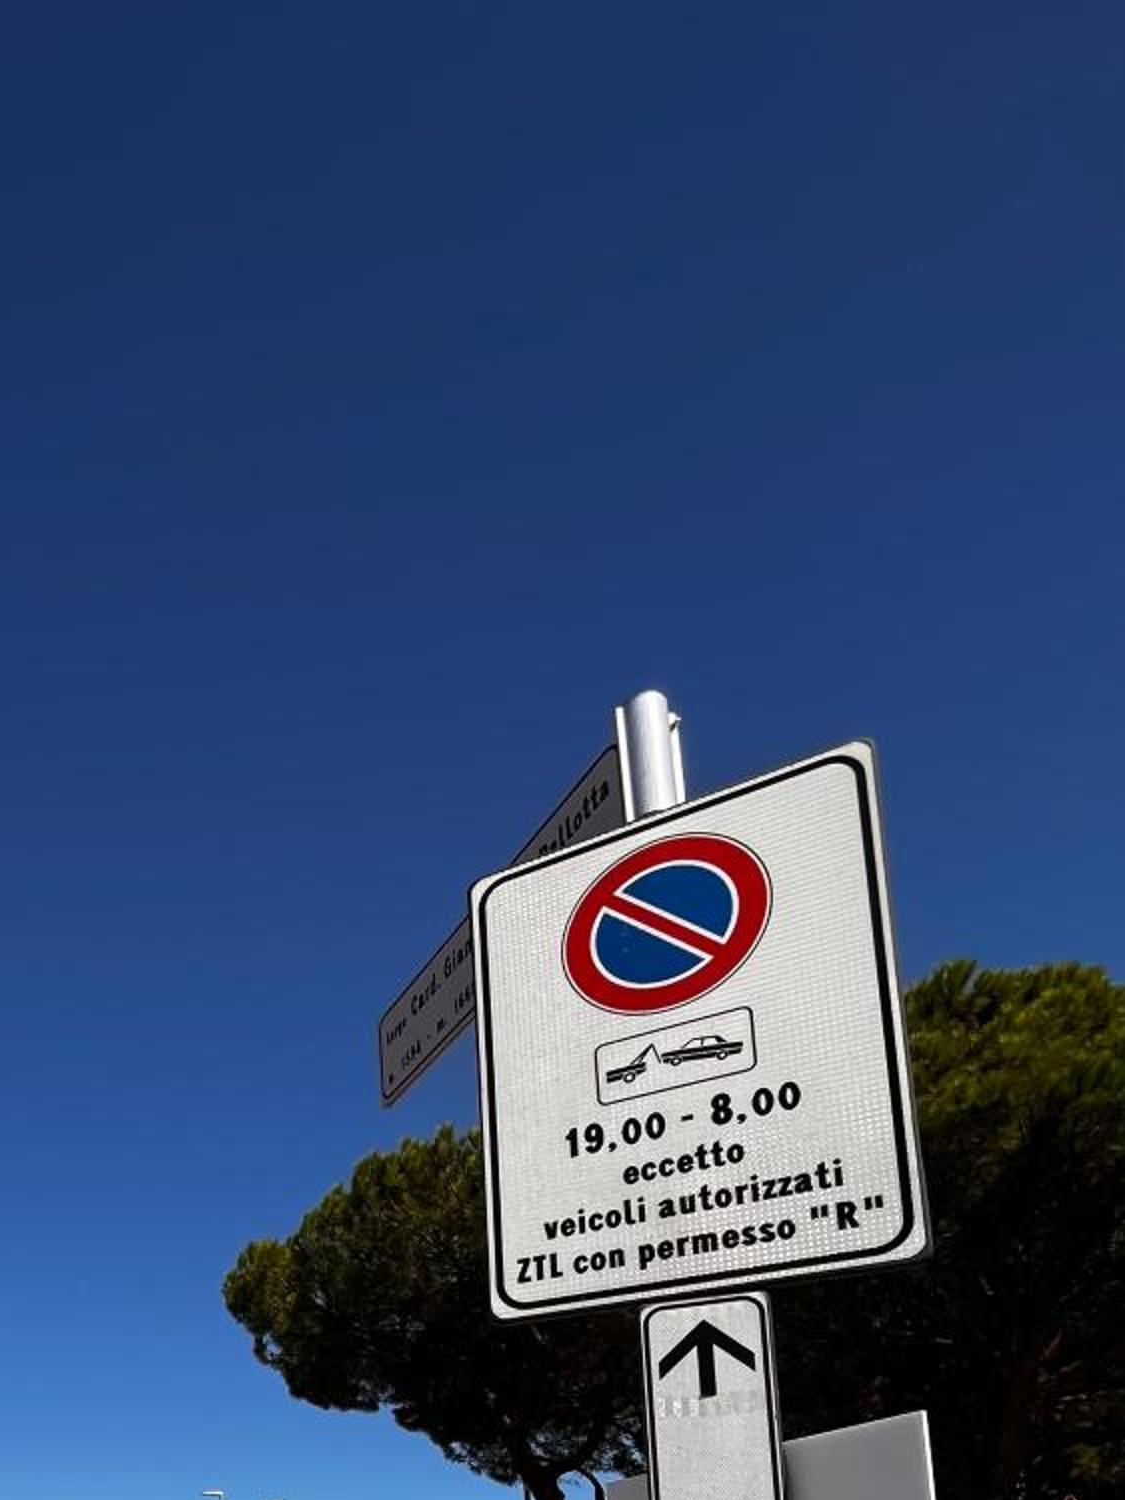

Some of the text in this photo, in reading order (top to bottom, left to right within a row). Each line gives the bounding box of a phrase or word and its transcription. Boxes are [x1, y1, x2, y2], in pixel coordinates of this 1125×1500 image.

[410, 973, 442, 1016] Card.
[680, 1113, 694, 1122] -
[623, 1141, 744, 1184] eccetto
[544, 1158, 844, 1240] veicoli autorizzati
[516, 1194, 884, 1284] ZTL con permesso "R"
